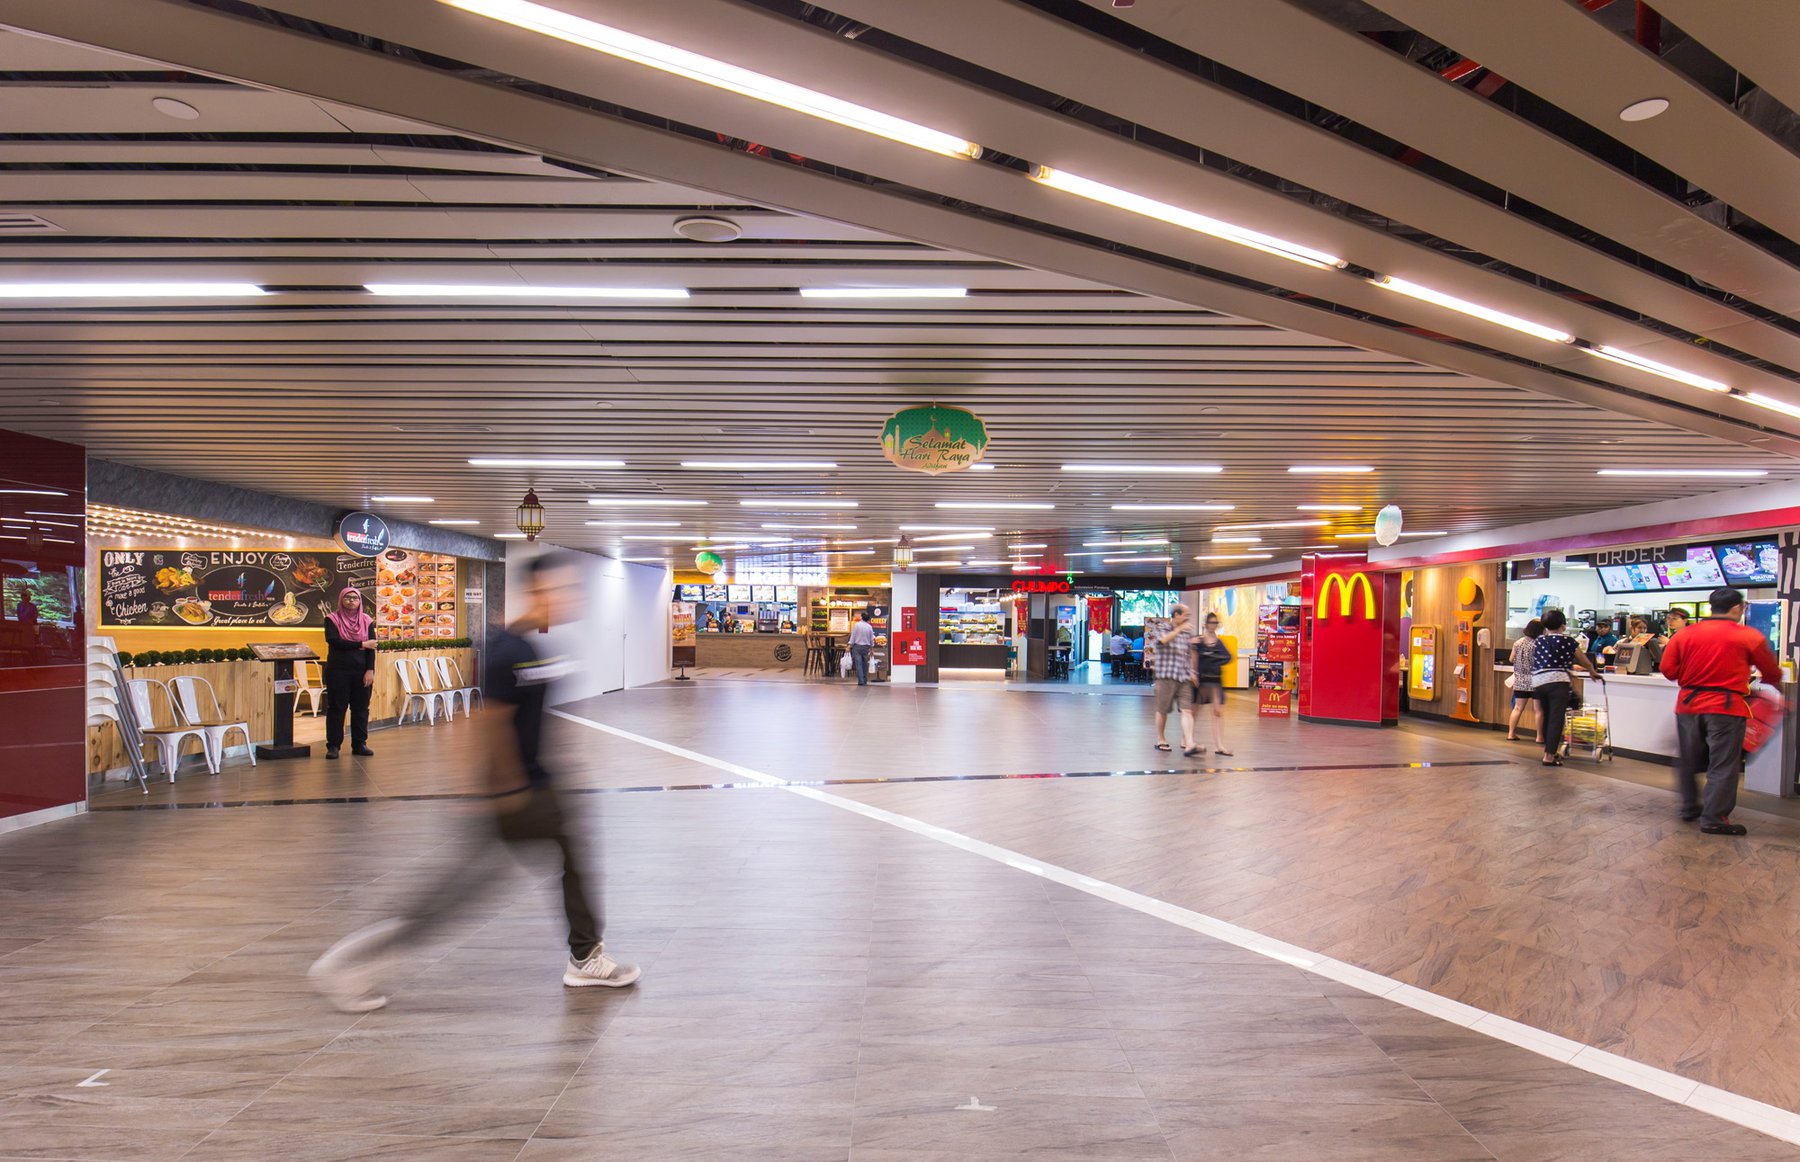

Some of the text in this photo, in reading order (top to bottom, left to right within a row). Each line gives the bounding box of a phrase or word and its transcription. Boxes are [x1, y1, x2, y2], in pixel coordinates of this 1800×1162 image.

[909, 435, 966, 450] Selamat
[900, 448, 970, 465] Hari Raya
[104, 551, 145, 567] ONLY
[211, 552, 268, 565] ENJOY
[1596, 546, 1666, 565] ORDER
[337, 558, 377, 570] Tenderfres
[208, 589, 264, 601] tenderfresh
[115, 600, 149, 617] Chicken
[211, 615, 268, 626] Great place to eat
